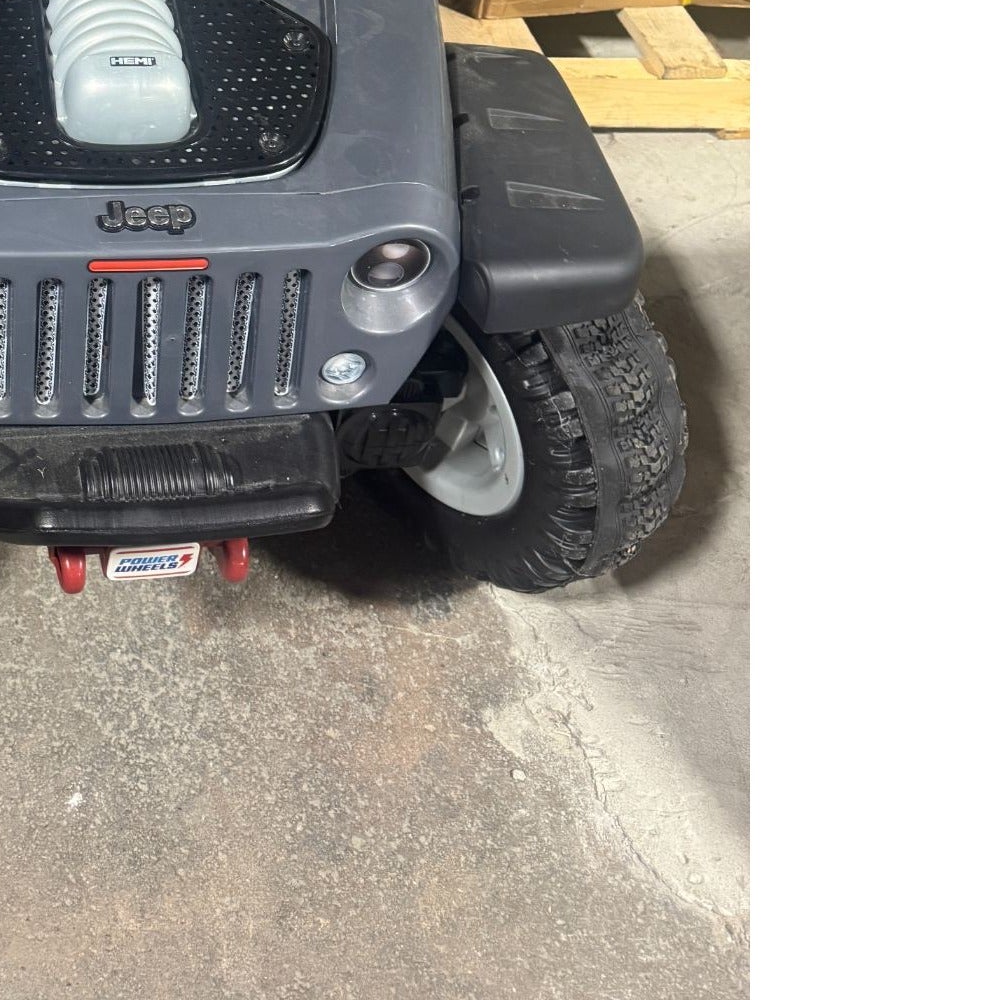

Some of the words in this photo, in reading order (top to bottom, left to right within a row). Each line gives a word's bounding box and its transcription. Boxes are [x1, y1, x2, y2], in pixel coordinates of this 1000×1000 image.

[110, 56, 154, 67] HEMI
[97, 200, 196, 235] Jeep
[119, 554, 178, 566] POWER
[115, 562, 178, 573] WHEELS
